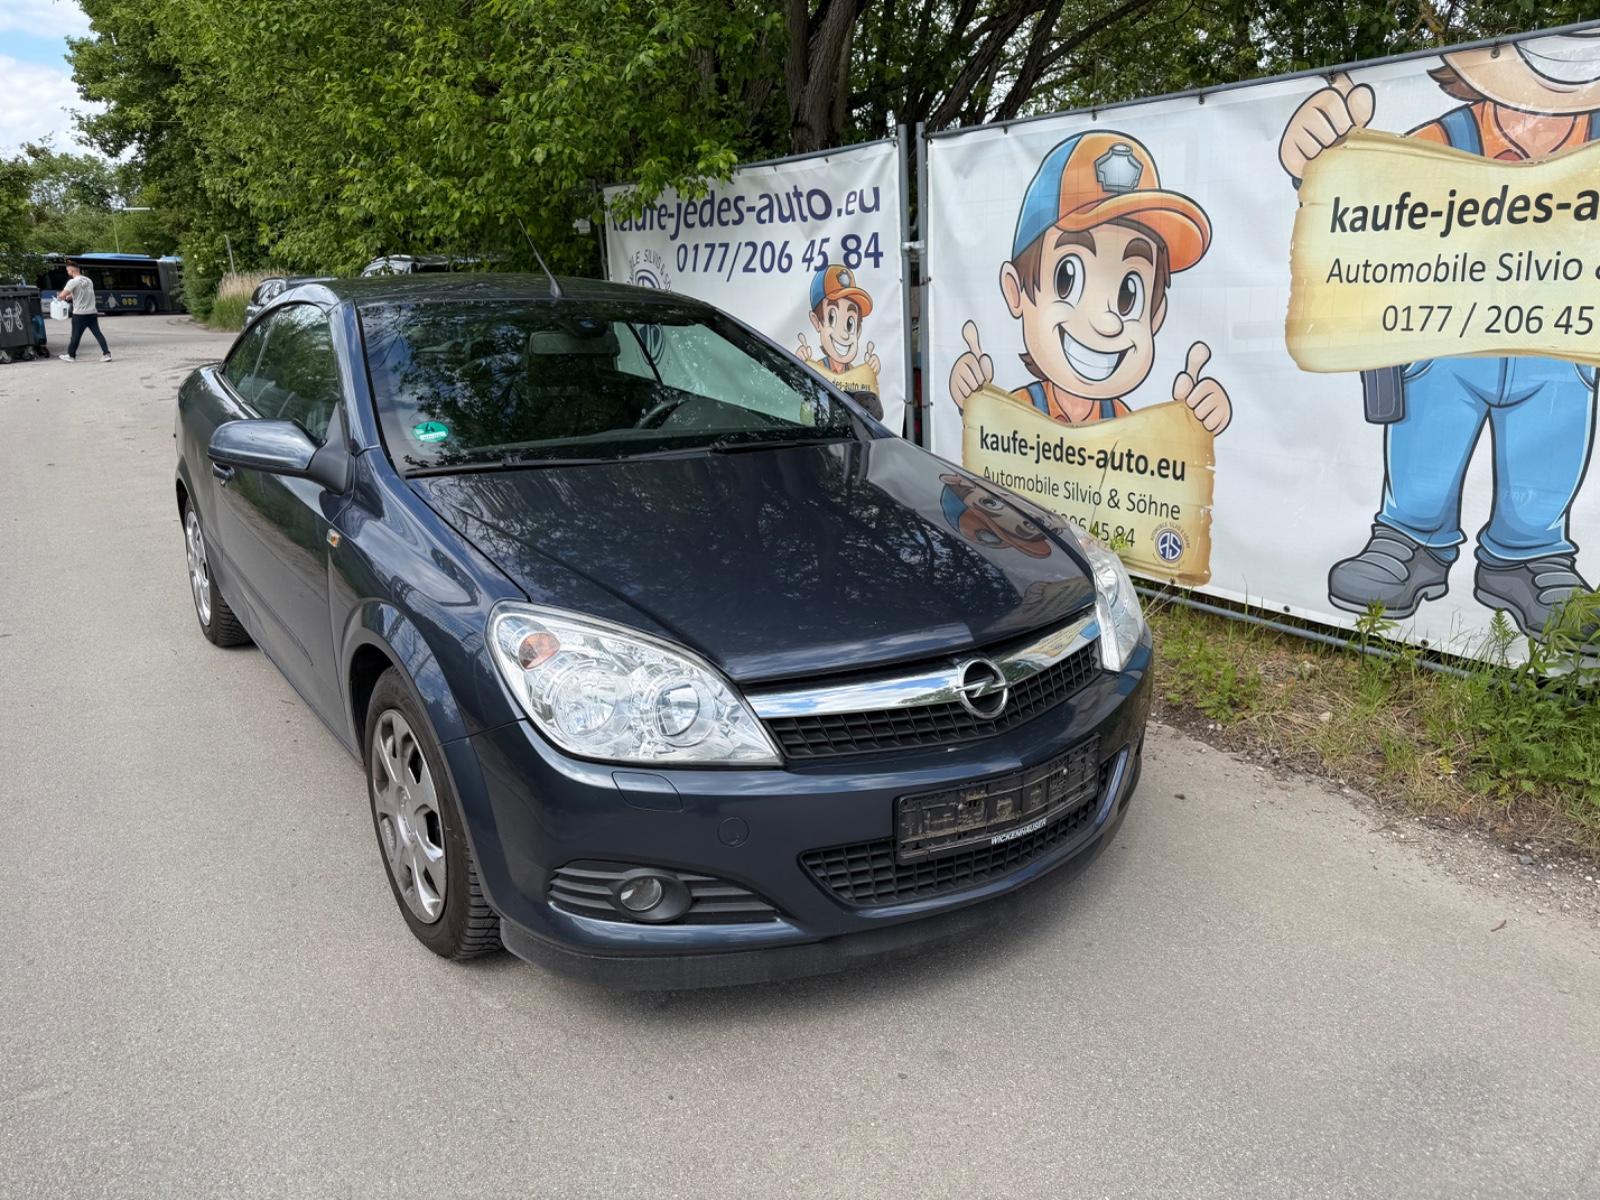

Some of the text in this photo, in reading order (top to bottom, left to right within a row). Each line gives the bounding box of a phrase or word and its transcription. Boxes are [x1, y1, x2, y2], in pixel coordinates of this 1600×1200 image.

[677, 240, 793, 282] 0177/206
[801, 237, 830, 272] 45
[840, 231, 883, 270] 84
[1327, 252, 1486, 284] Automobile
[1496, 250, 1583, 281] Silvio
[1382, 302, 1594, 338] 0177 / 206 45
[980, 426, 1186, 482] kaufe-jedes-auto.eu
[984, 466, 1181, 521] Automobile Silvio & Söhne
